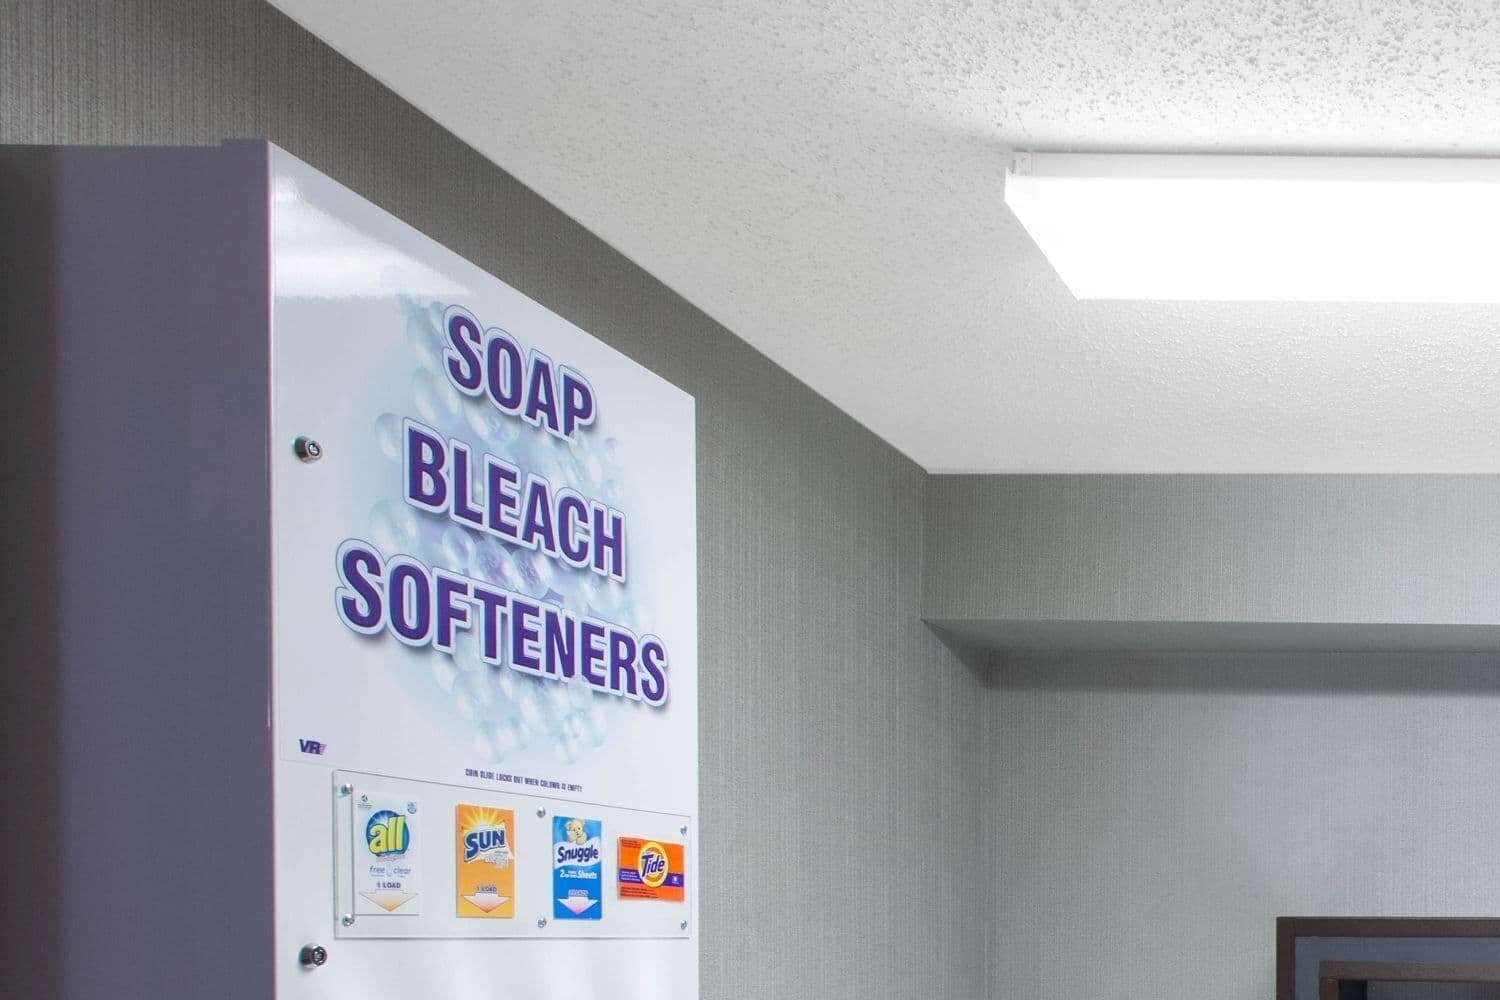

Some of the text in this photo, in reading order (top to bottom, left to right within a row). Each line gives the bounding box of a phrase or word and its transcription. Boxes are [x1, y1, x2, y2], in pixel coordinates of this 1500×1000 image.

[444, 308, 596, 439] SOAP
[406, 422, 625, 580] BLEACH
[339, 543, 667, 705] SOFTENERS
[465, 768, 479, 777] COIN
[480, 770, 495, 780] SLIDE
[496, 773, 513, 783] LOCKS
[513, 776, 524, 784] OUT
[525, 777, 540, 786] WHEN
[567, 783, 583, 792] EMPTY
[369, 814, 406, 855] all
[464, 829, 507, 862] SUN
[369, 865, 411, 875] free clear
[557, 844, 600, 863] Snuggle
[641, 852, 666, 878] Tide
